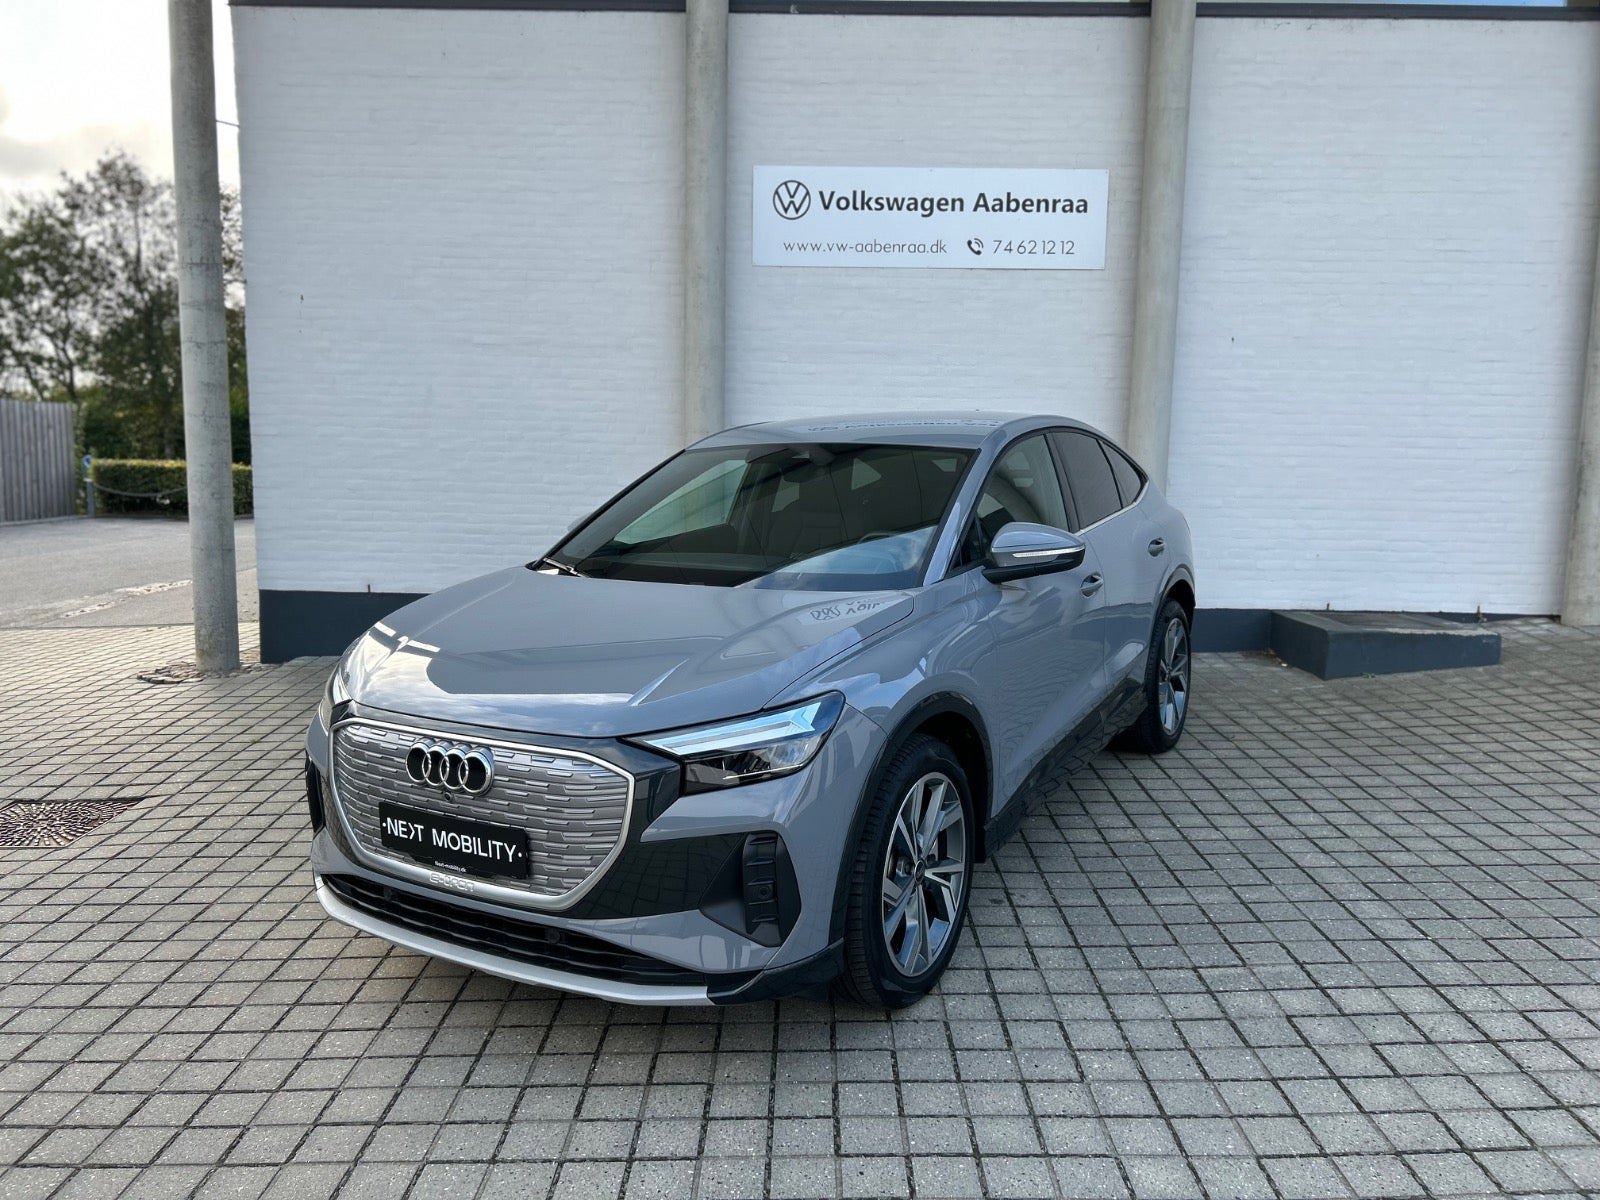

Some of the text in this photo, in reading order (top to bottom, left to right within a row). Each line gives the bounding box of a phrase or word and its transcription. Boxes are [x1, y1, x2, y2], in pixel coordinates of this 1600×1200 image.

[819, 190, 1088, 217] Volkswagen Aabenraa
[783, 239, 948, 254] www.vw-aabenraa.dk
[431, 828, 517, 863] MOBILITY
